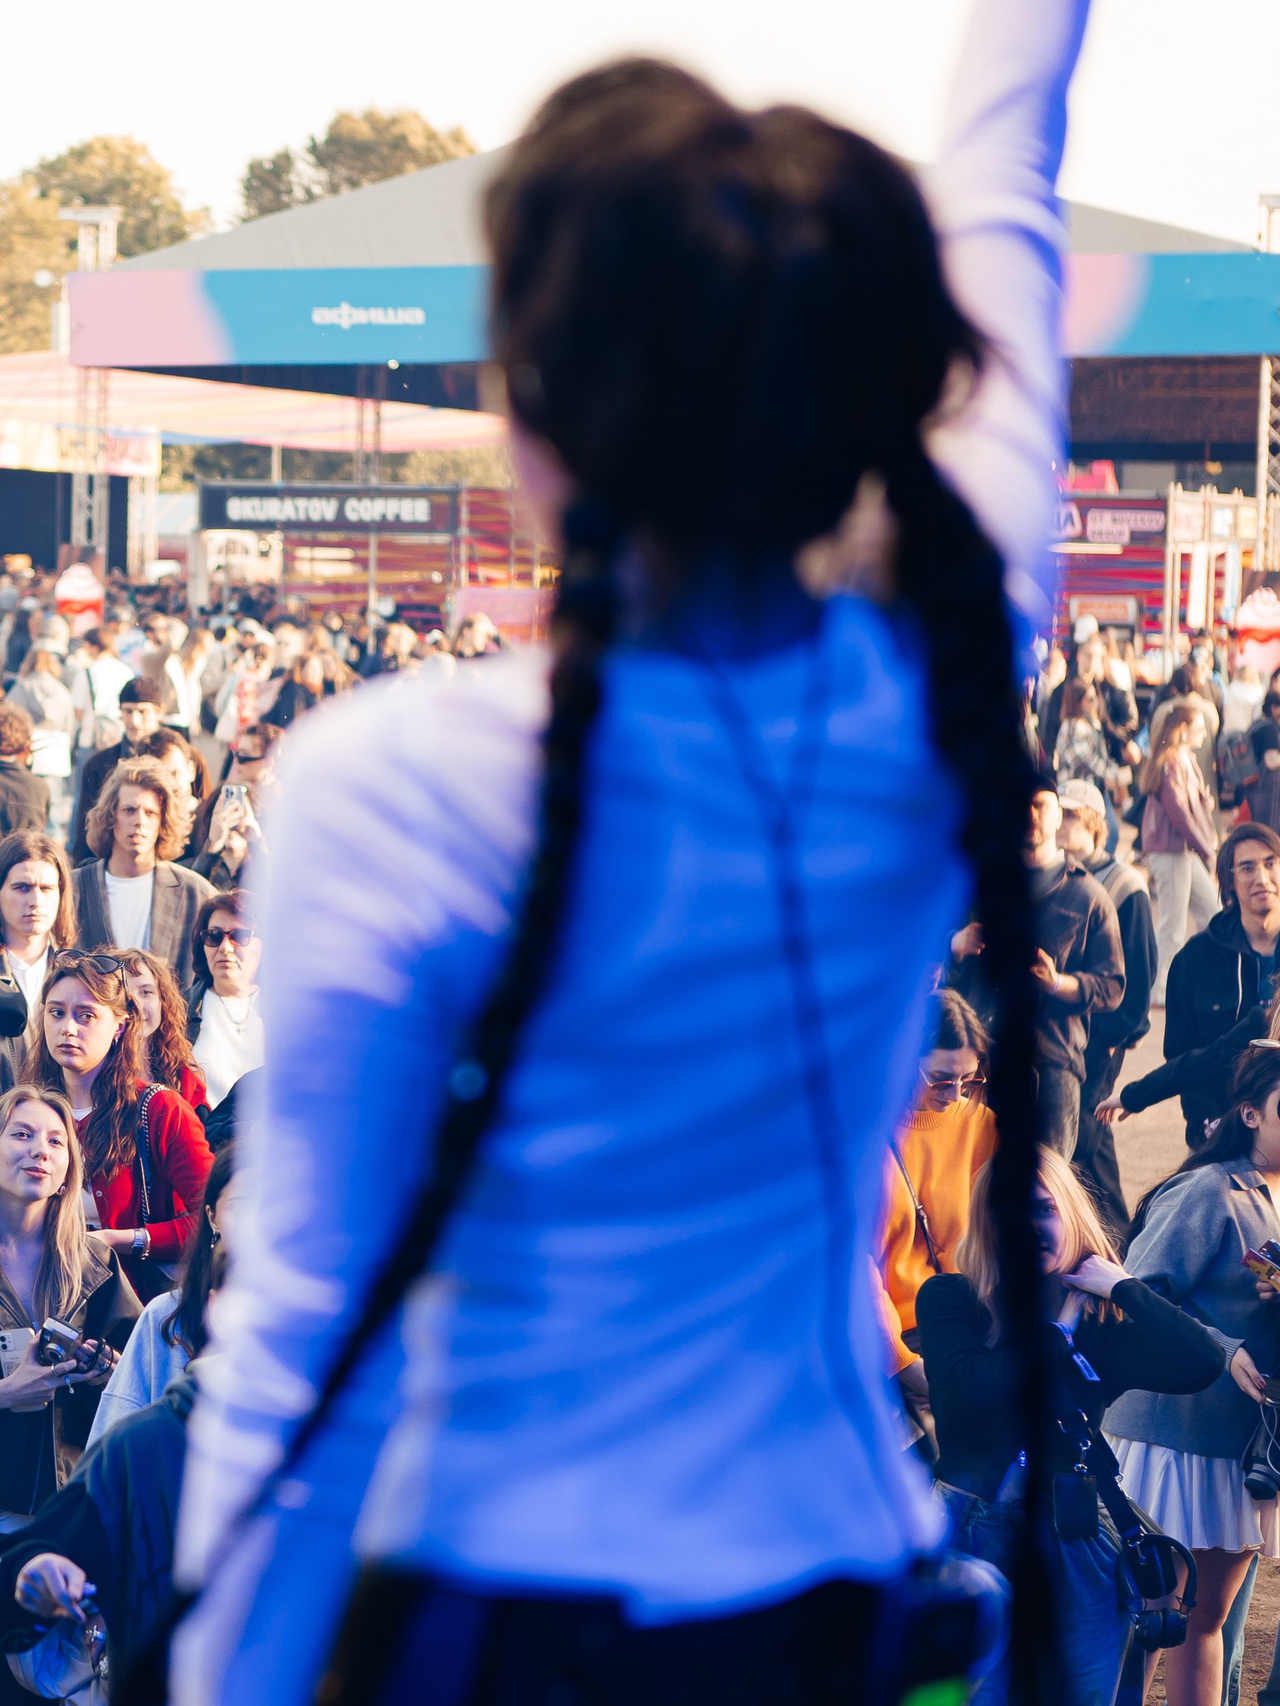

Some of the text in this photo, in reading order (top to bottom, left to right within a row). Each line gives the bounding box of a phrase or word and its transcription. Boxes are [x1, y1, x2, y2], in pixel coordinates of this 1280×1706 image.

[312, 301, 425, 329] афиша
[226, 496, 431, 523] SKURATOV COFFEE
